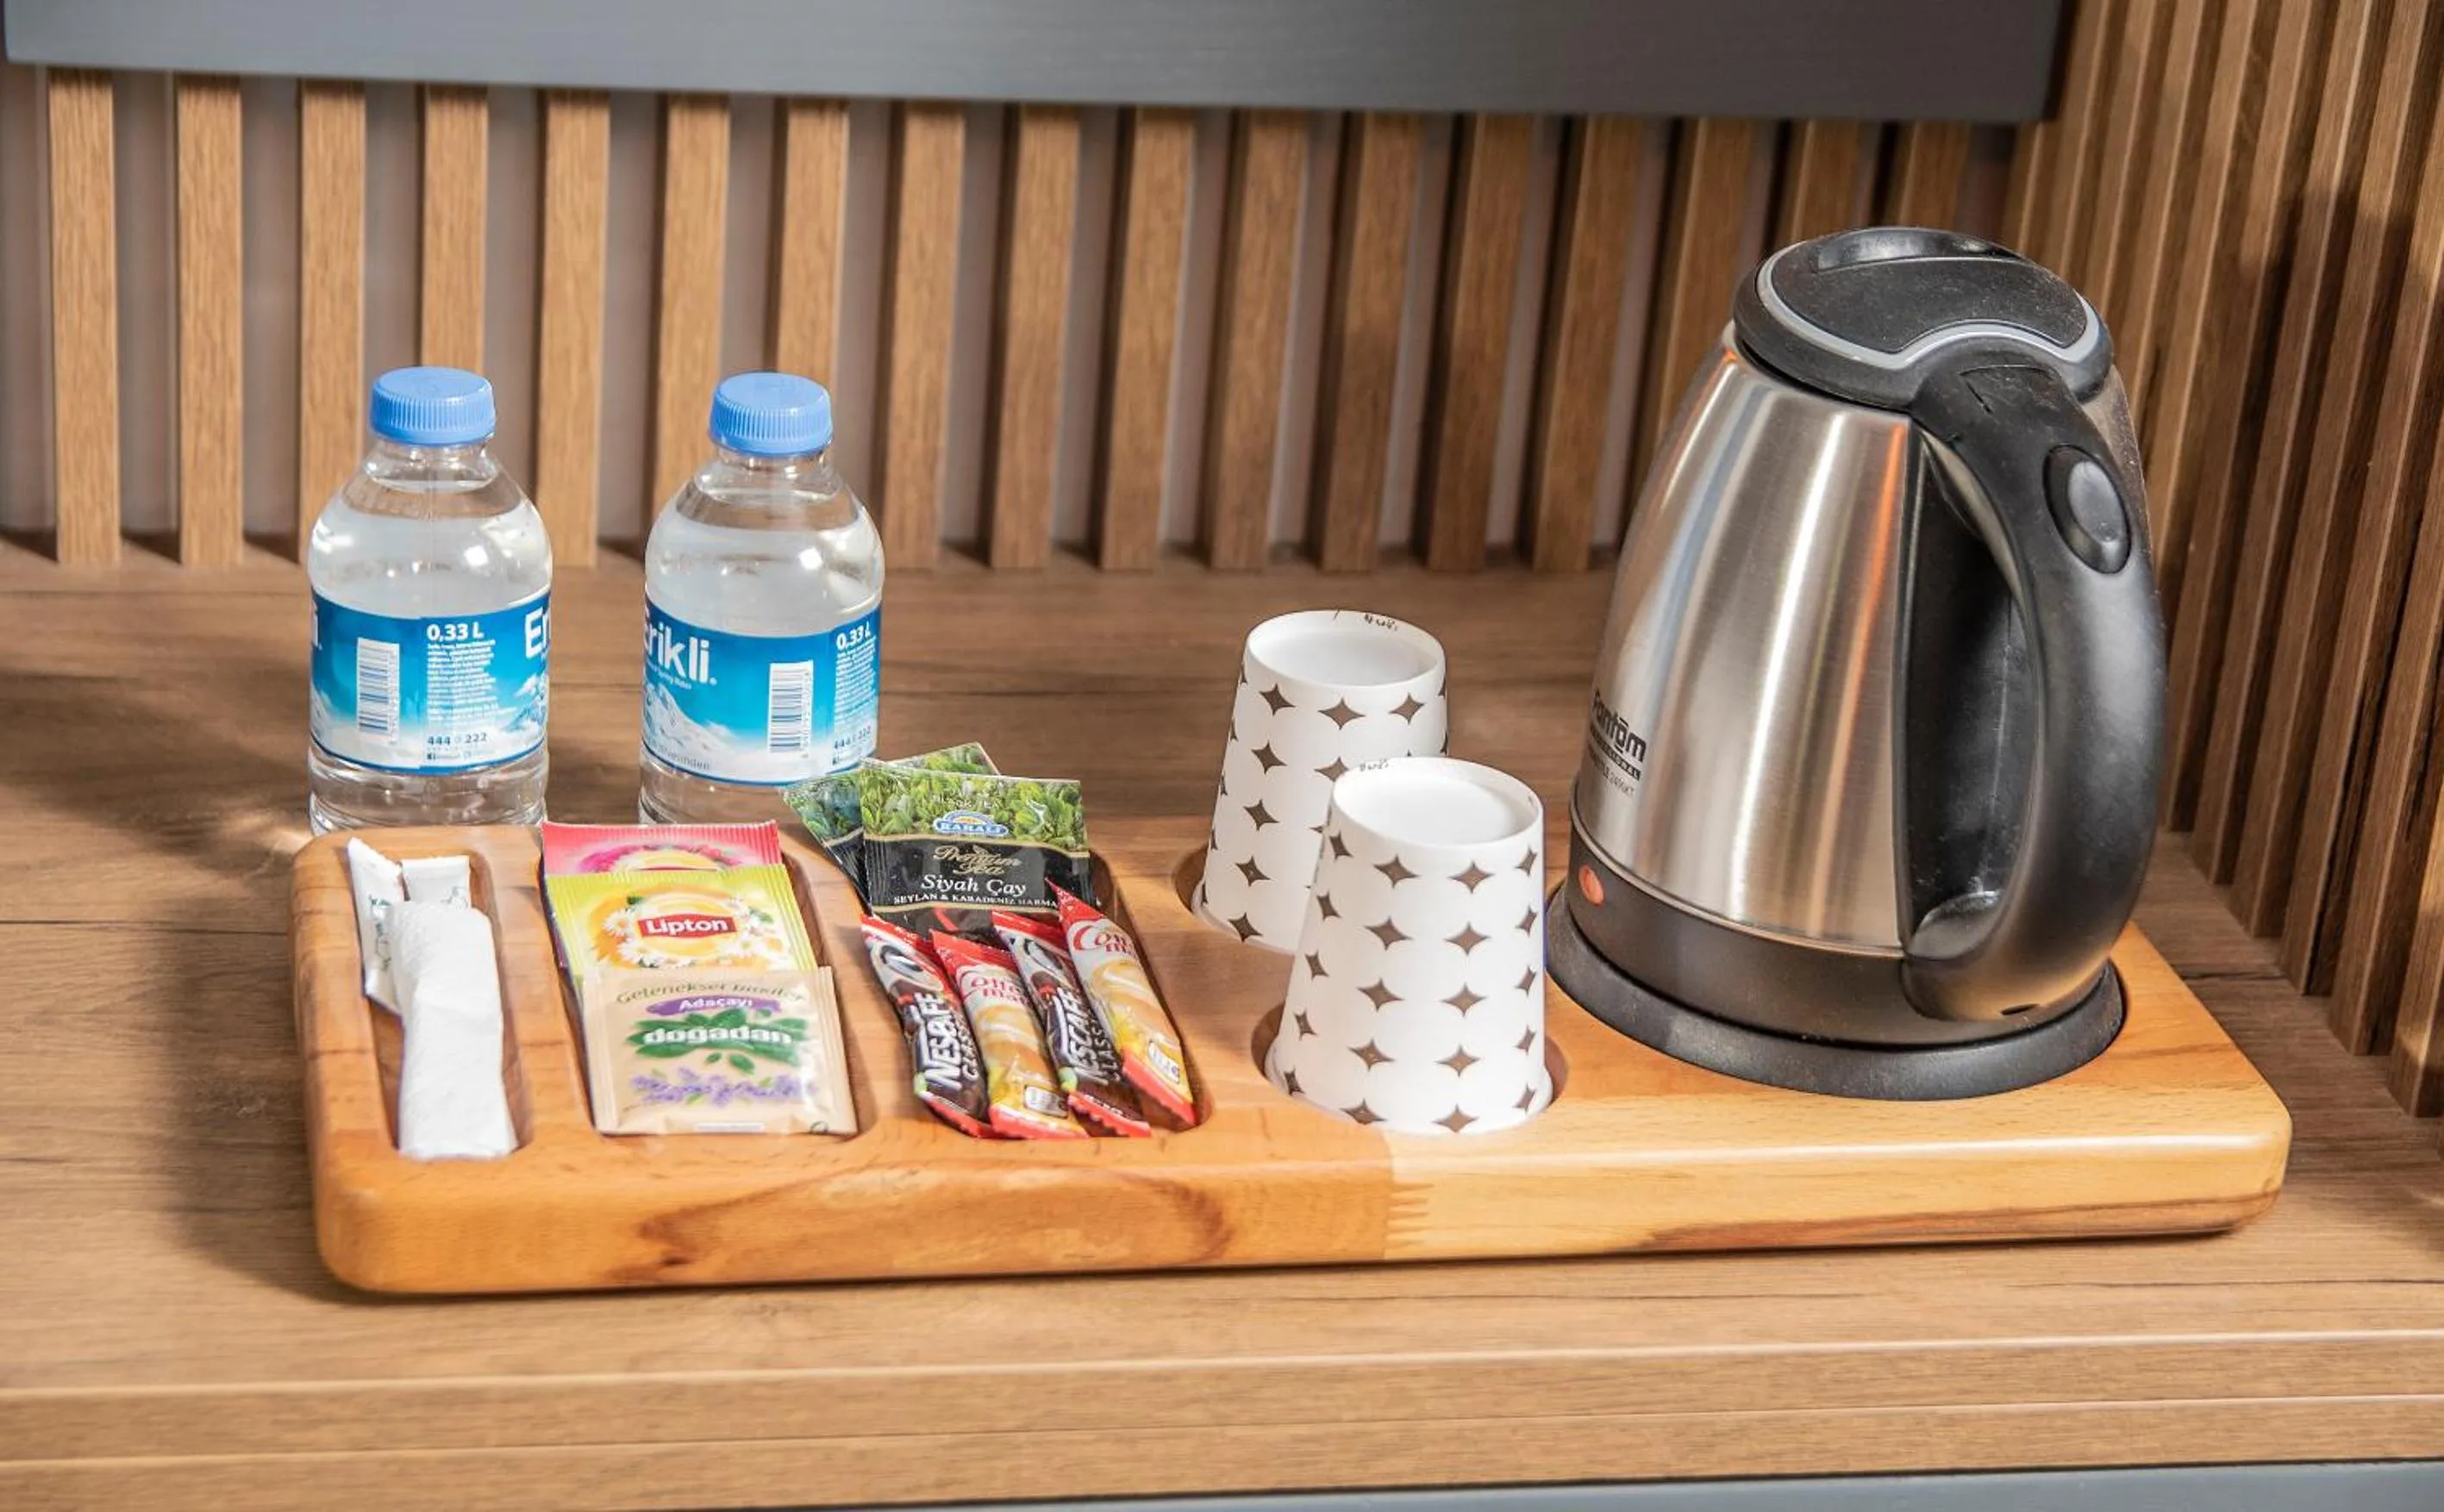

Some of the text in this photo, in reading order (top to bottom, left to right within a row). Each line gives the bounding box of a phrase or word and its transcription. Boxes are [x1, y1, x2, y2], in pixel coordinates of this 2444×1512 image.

[426, 621, 484, 642] 0,33 L
[427, 735, 451, 746] 444
[466, 732, 488, 744] 222
[933, 845, 1022, 867] Premium
[920, 874, 1027, 897] Siyah Çay
[894, 893, 939, 905] SEYLAN
[646, 918, 729, 935] Lipton
